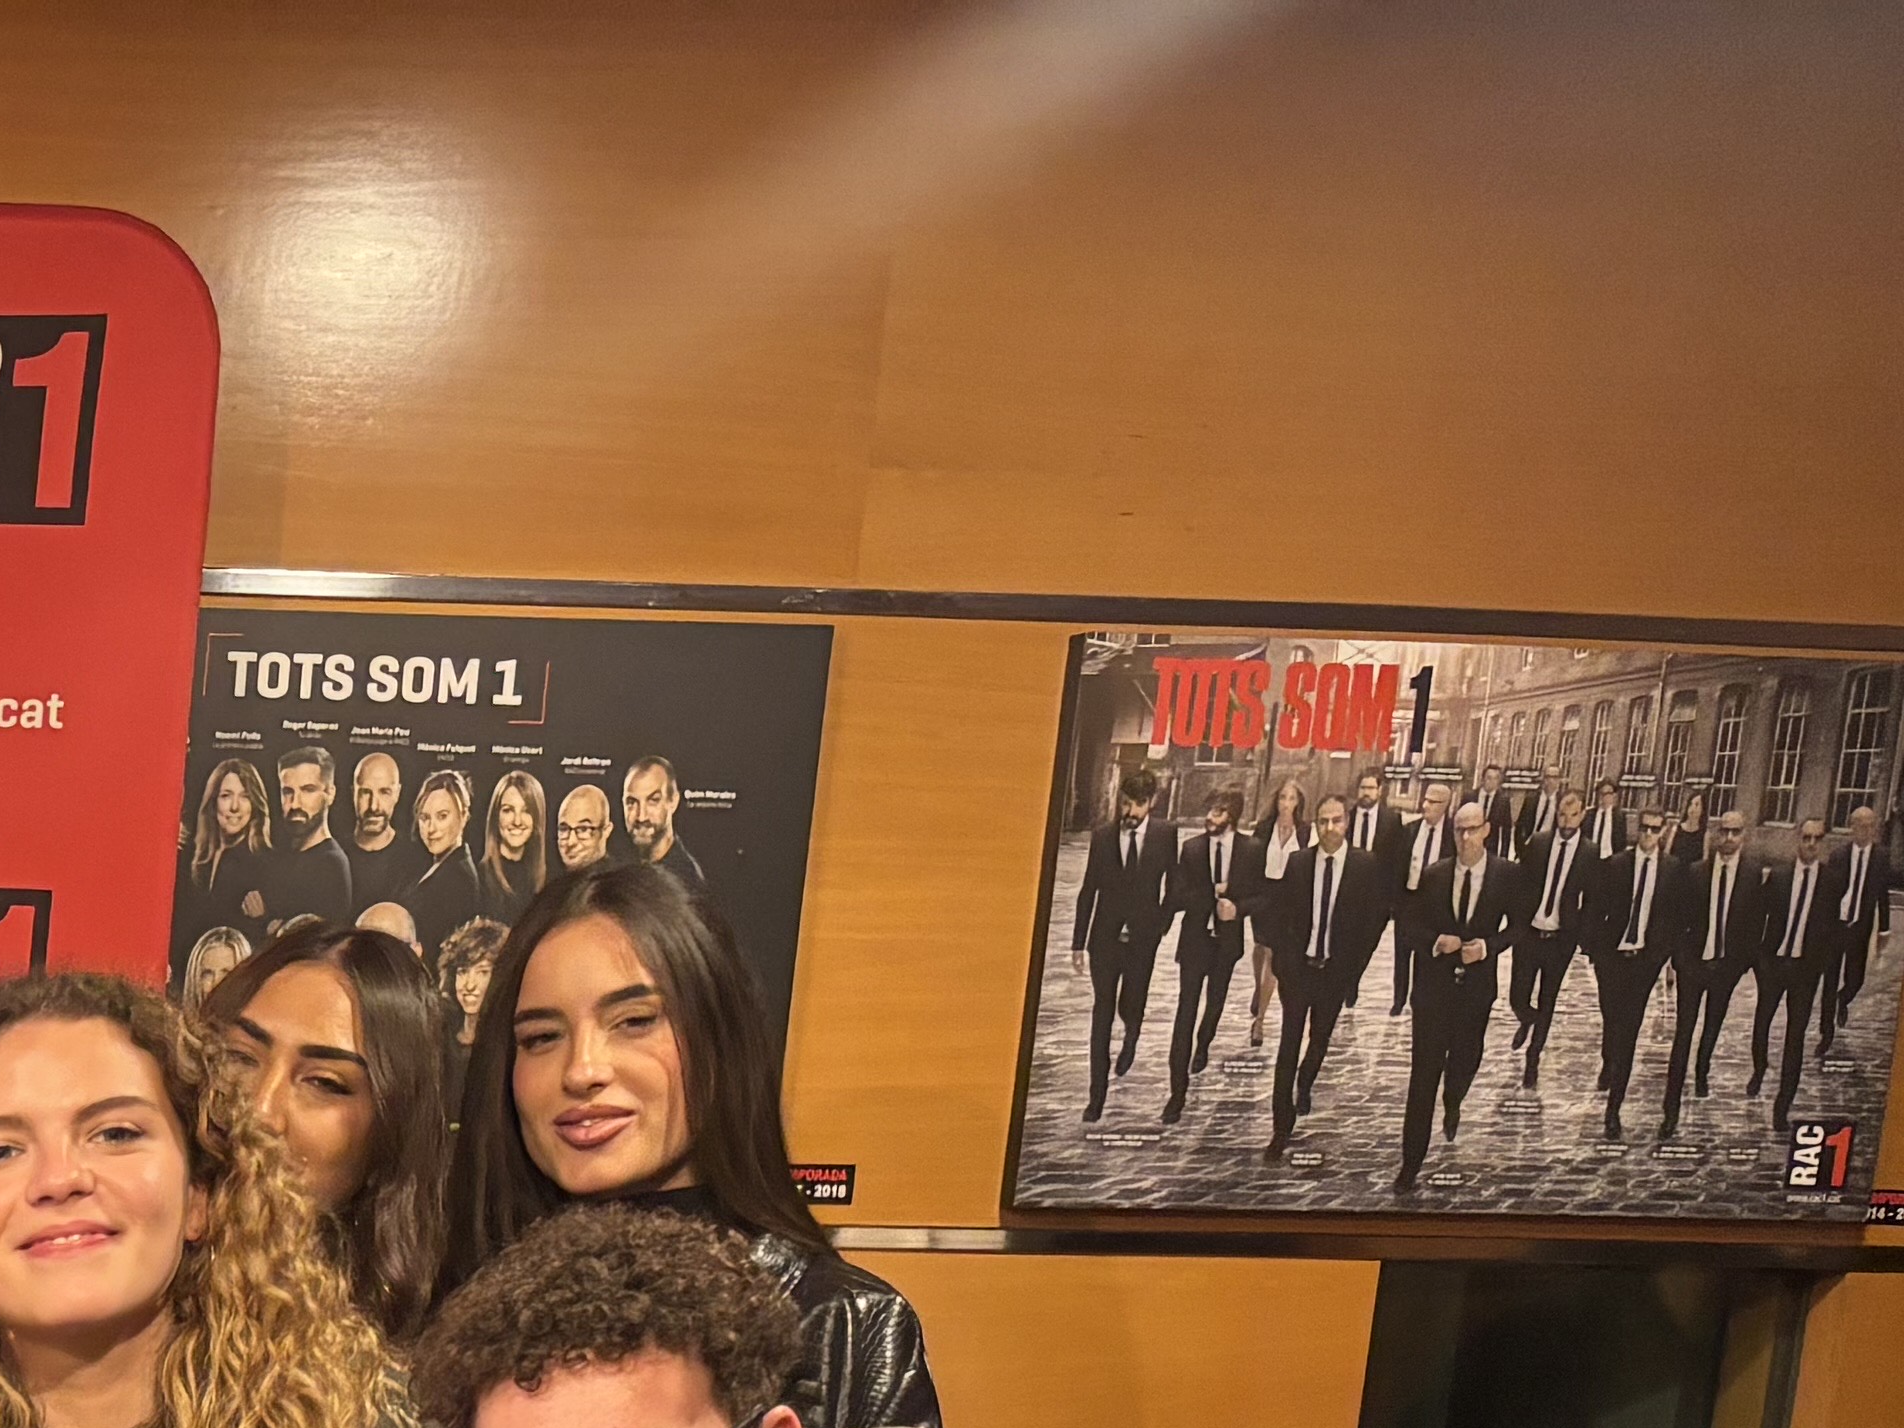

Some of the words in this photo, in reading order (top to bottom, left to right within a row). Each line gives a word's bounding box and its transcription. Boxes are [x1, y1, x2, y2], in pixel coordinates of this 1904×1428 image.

[14, 332, 90, 508] 1
[228, 651, 354, 700] TOTS
[367, 656, 480, 704] SOM
[493, 659, 522, 705] 1
[1151, 657, 1271, 748] TOTS
[1277, 662, 1400, 751] SOM
[1410, 666, 1433, 753] 1
[1790, 1126, 1824, 1185] RAC
[1828, 1128, 1851, 1187] 1
